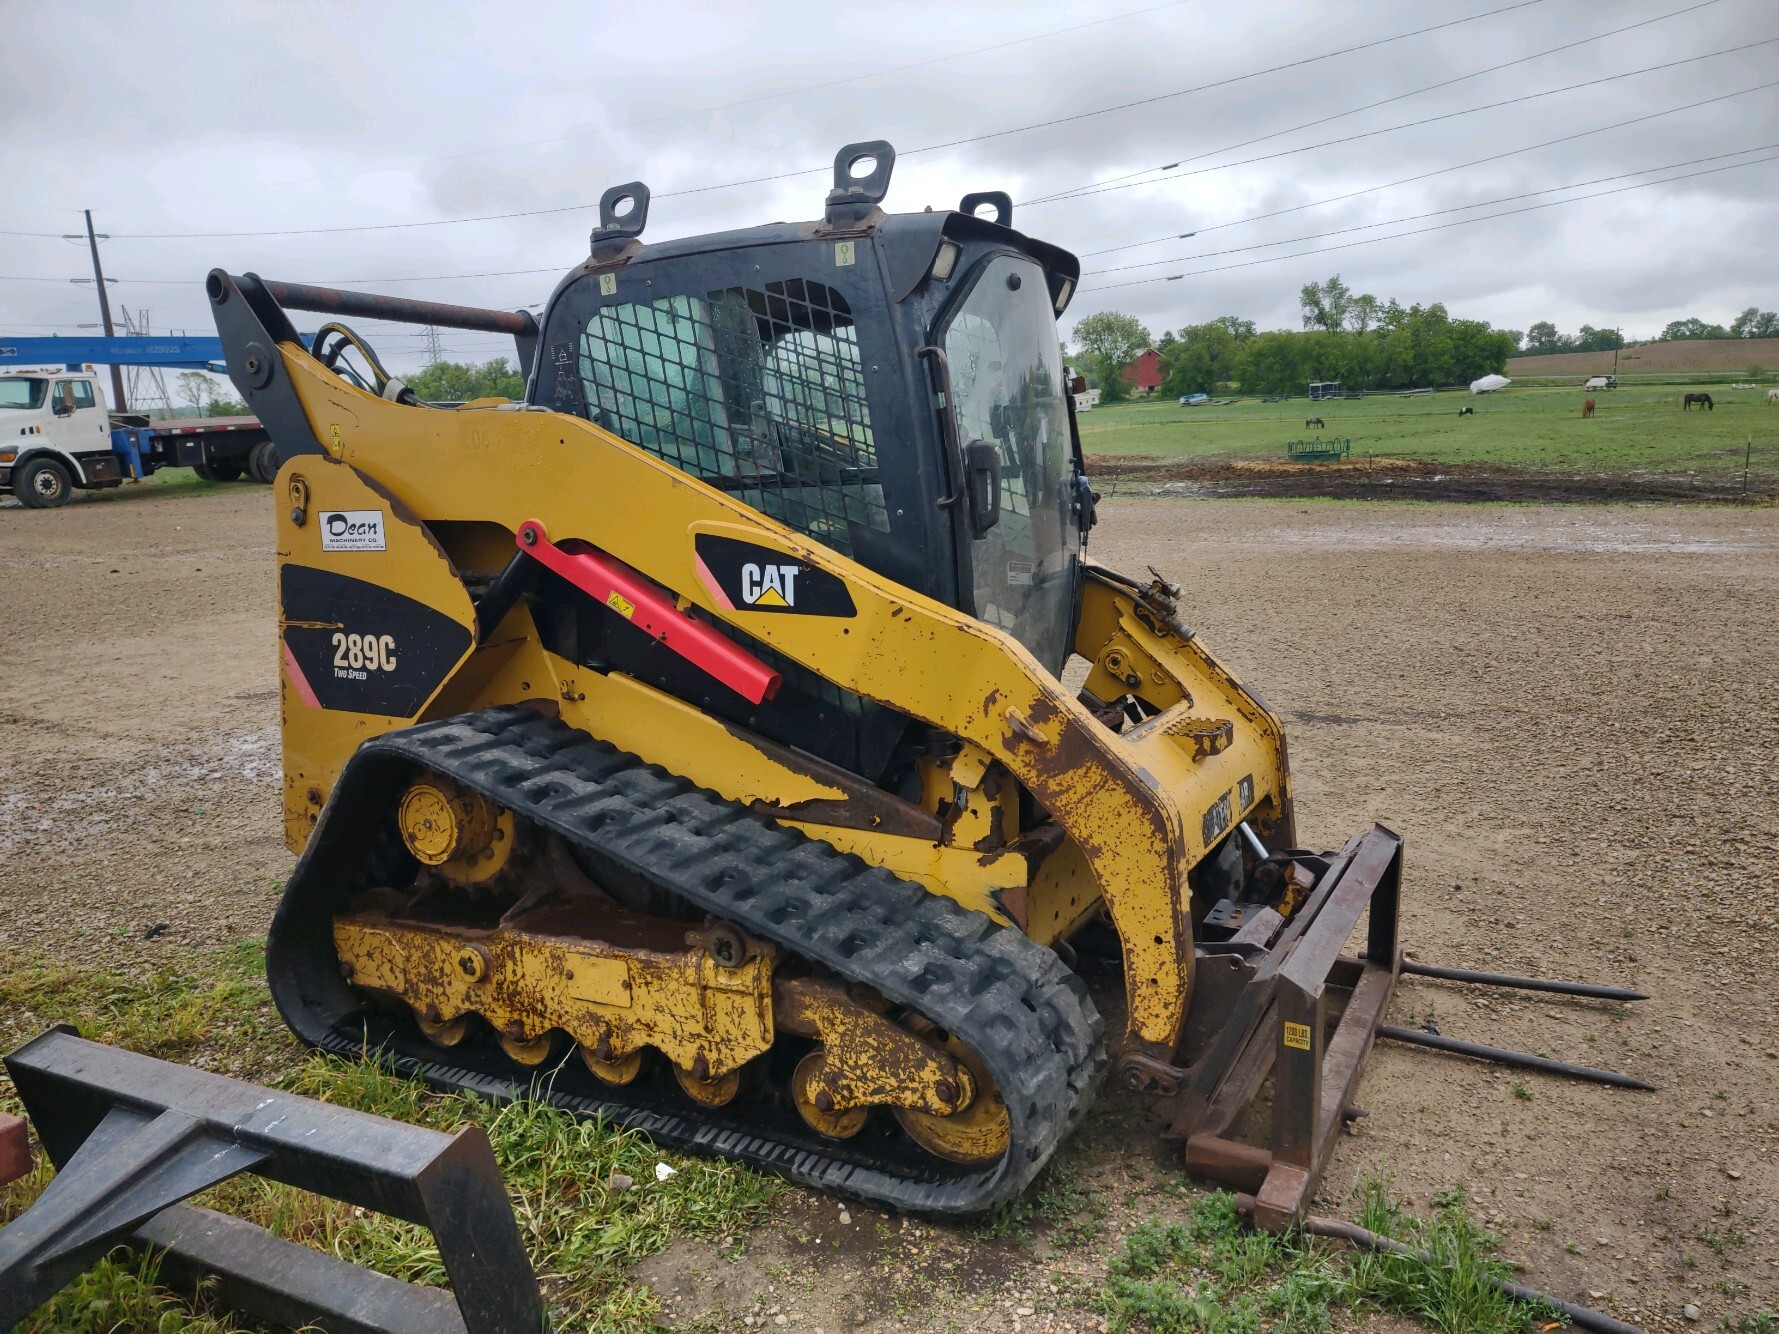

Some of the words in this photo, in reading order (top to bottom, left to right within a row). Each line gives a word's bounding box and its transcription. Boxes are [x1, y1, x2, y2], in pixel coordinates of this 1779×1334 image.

[326, 513, 378, 537] Dean
[741, 563, 799, 607] CAT
[332, 632, 397, 672] 289C
[347, 669, 367, 681] SPEED
[1286, 1035, 1309, 1046] CAPACITY
